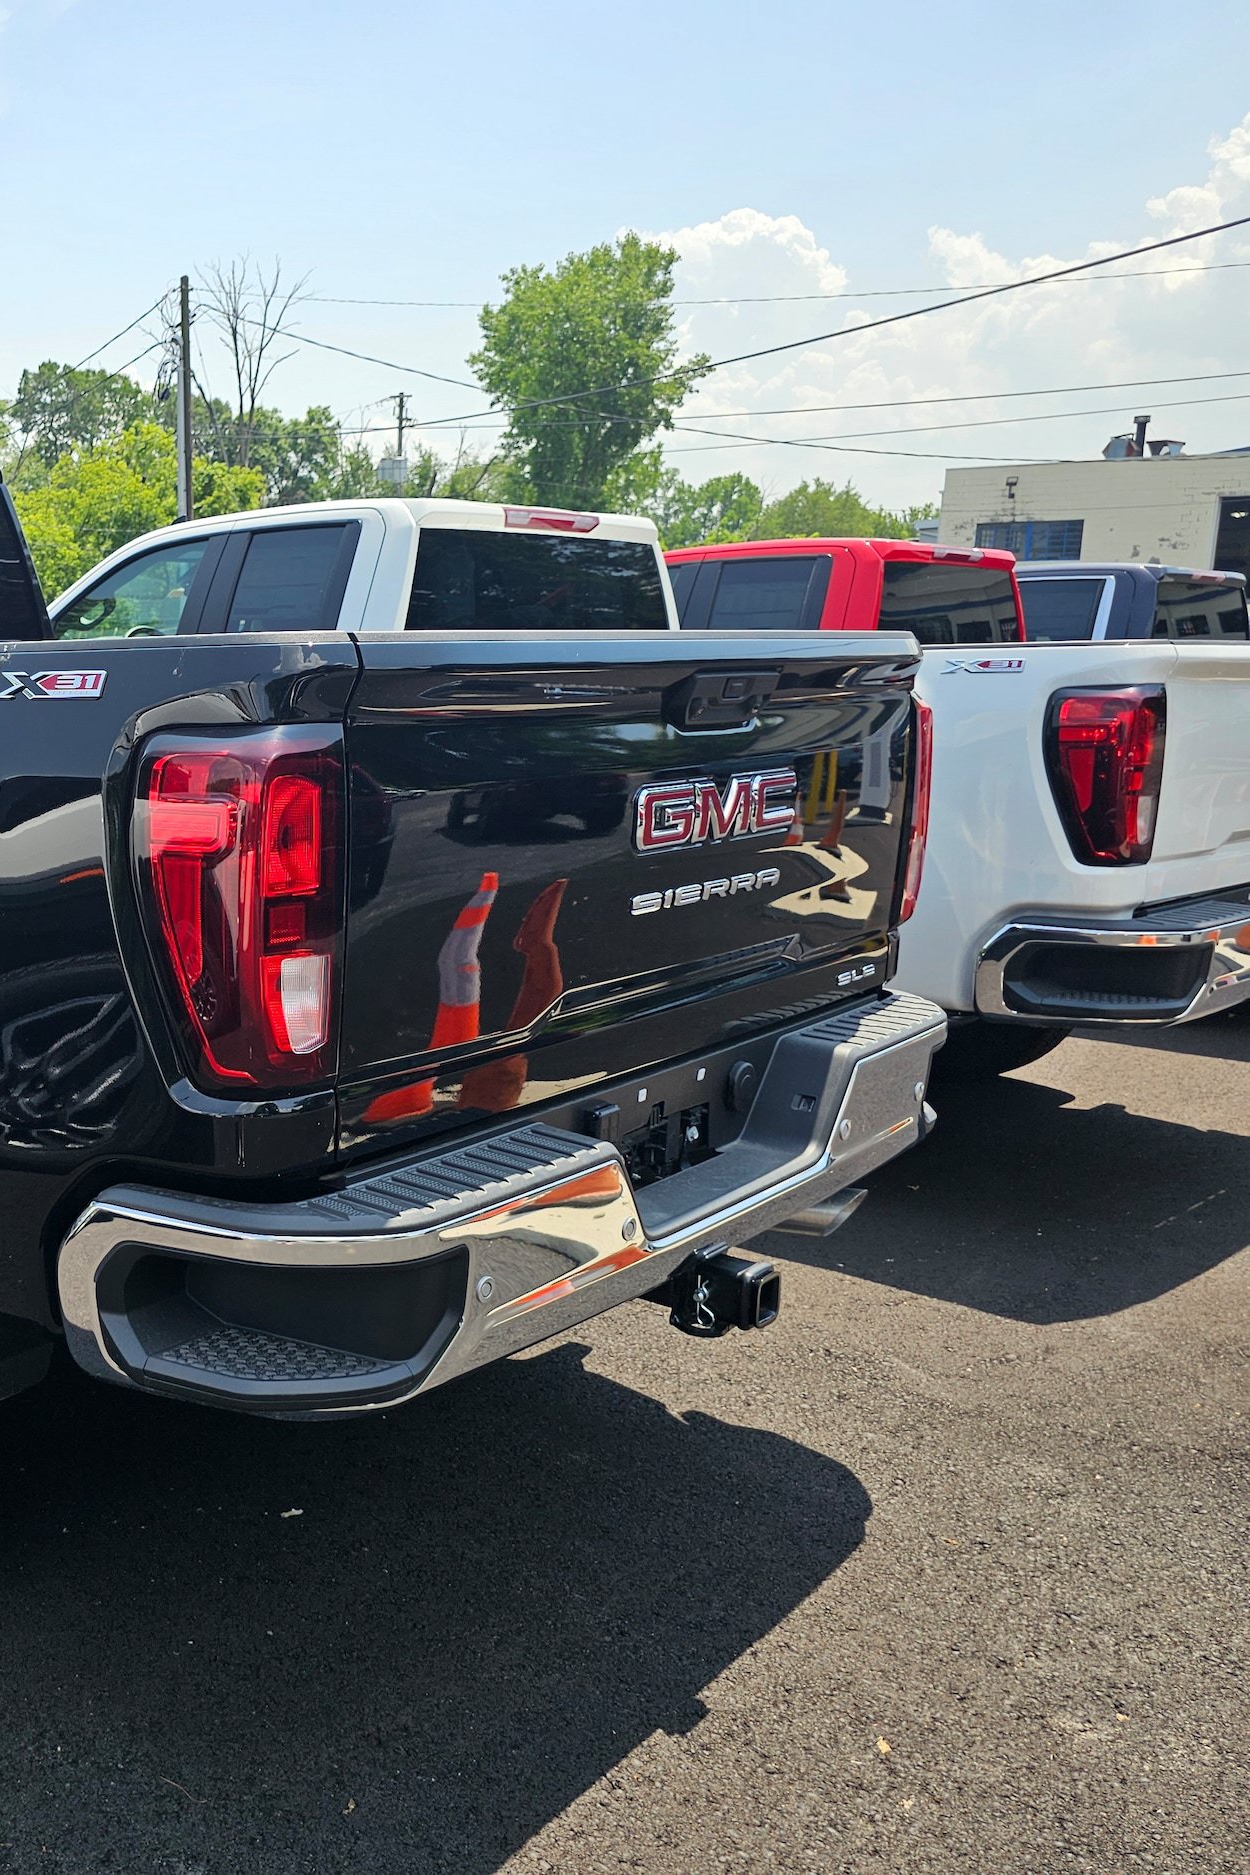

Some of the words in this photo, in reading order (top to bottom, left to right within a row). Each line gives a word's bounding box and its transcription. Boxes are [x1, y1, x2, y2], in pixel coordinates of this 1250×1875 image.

[633, 769, 797, 856] GMC
[630, 867, 780, 916] SIERRA
[837, 963, 876, 987] SLE
